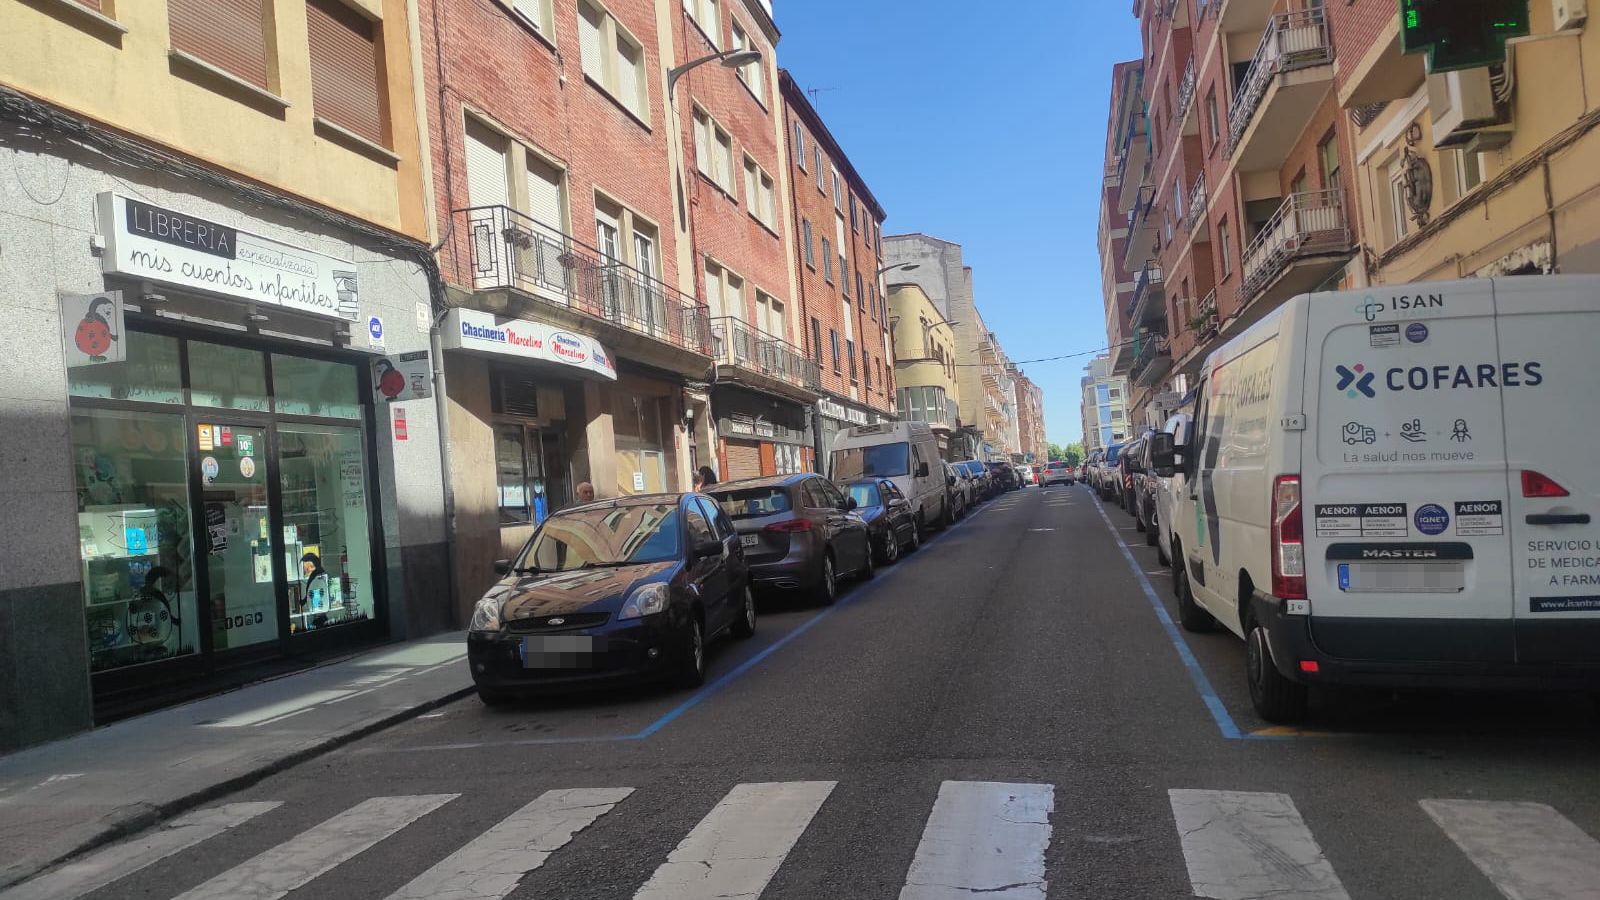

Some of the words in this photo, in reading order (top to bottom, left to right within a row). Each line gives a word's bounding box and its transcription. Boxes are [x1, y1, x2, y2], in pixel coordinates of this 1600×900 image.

[239, 247, 314, 276] especializada
[130, 248, 173, 273] mis
[181, 261, 253, 291] cuentos
[1392, 294, 1443, 310] ISAN
[461, 321, 506, 342] Chacineria
[506, 328, 543, 349] Marcelino
[552, 341, 587, 360] Marcelino
[1386, 362, 1543, 391] COFARES
[1343, 452, 1359, 463] La
[1363, 451, 1398, 462] salud
[1402, 452, 1426, 461] nos
[1430, 451, 1475, 461] mueve
[1320, 507, 1357, 515] AENOR
[1365, 506, 1403, 514] AENOR
[1459, 503, 1498, 513] AENOR
[1419, 516, 1447, 524] IQNET
[1528, 540, 1591, 551] SERVICIO
[1363, 549, 1438, 558] MASTER
[1528, 558, 1546, 568] DE
[1549, 575, 1558, 585] A
